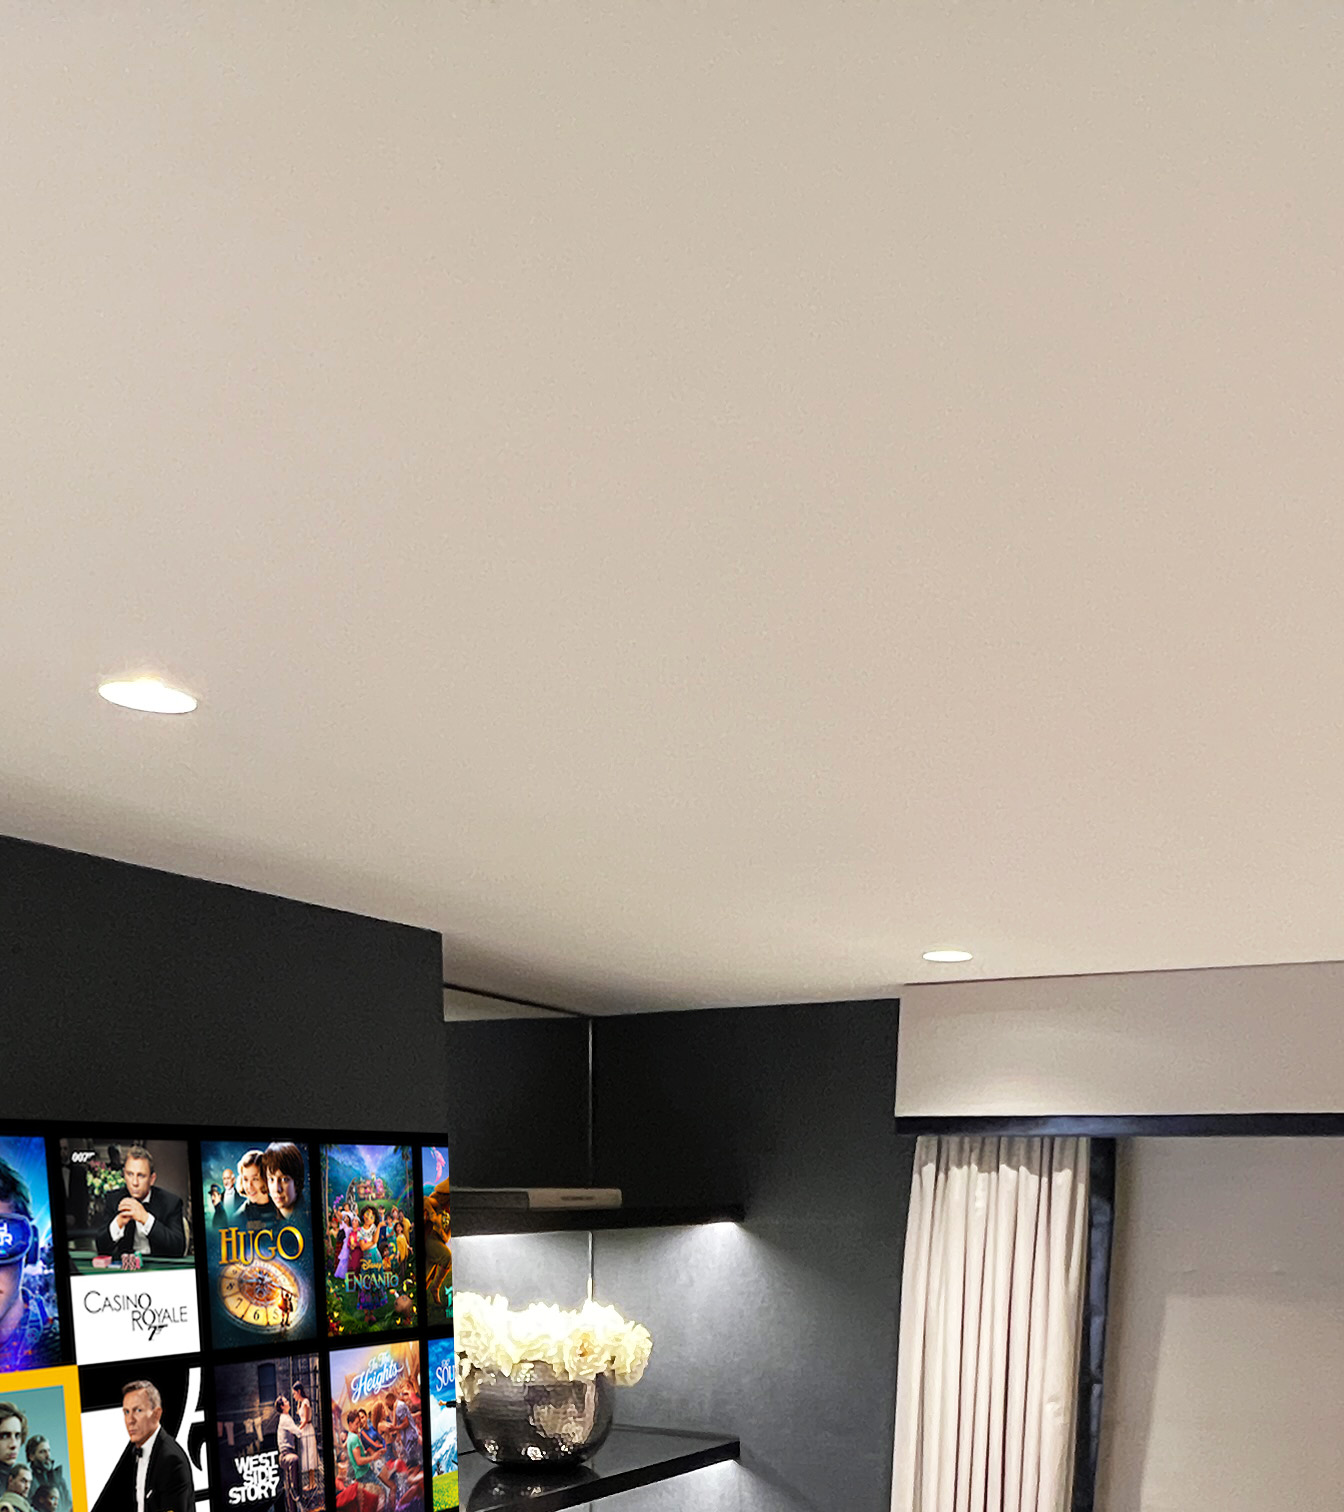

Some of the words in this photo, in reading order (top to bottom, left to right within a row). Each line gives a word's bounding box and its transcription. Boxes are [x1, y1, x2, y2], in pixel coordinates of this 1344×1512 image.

[218, 1225, 304, 1266] HUGO
[345, 1271, 399, 1293] ENCANTO
[83, 1290, 152, 1314] CASINO
[131, 1305, 189, 1332] ROYALE
[351, 1361, 404, 1403] Heights
[234, 1450, 279, 1474] WEST
[242, 1464, 279, 1487] SIDE
[228, 1476, 280, 1504] STORY
